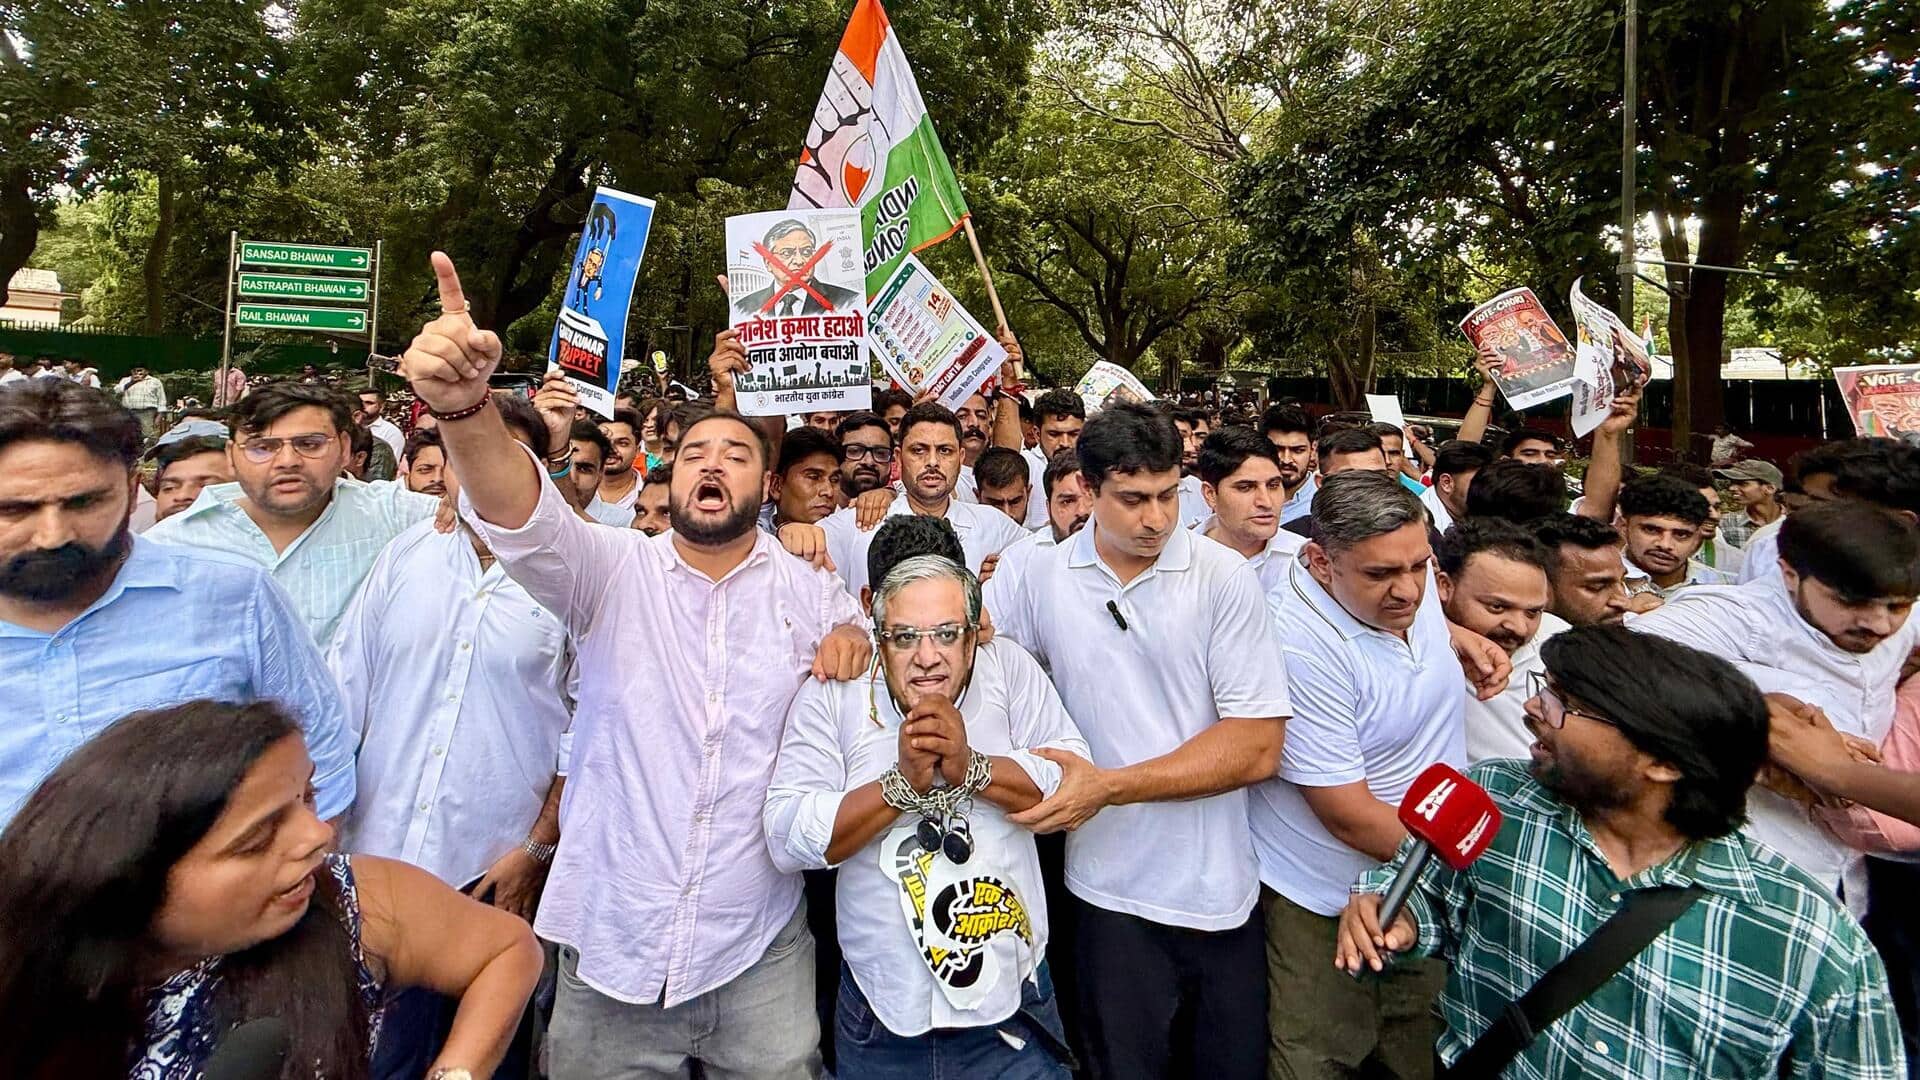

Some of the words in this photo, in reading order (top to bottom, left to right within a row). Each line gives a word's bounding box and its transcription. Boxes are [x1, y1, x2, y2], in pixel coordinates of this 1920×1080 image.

[245, 248, 289, 260] SANSAD
[290, 251, 335, 264] BHAWAN
[242, 280, 303, 293] RASTRAPATI
[303, 283, 347, 294] BHAWAN
[927, 292, 941, 310] 14
[240, 311, 264, 321] RAIL
[265, 311, 310, 323] BHAWAN
[780, 317, 821, 344] कुमार
[823, 310, 864, 338] हटाओ
[571, 331, 605, 358] KUMAR
[747, 348, 777, 366] नाव
[779, 342, 818, 362] आयोग
[820, 340, 859, 360] बचाओ
[972, 355, 993, 377] Congress
[774, 391, 804, 403] भारतीय
[806, 390, 820, 404] युवा
[821, 389, 845, 400] कांग्रेस
[974, 881, 1005, 907] एक
